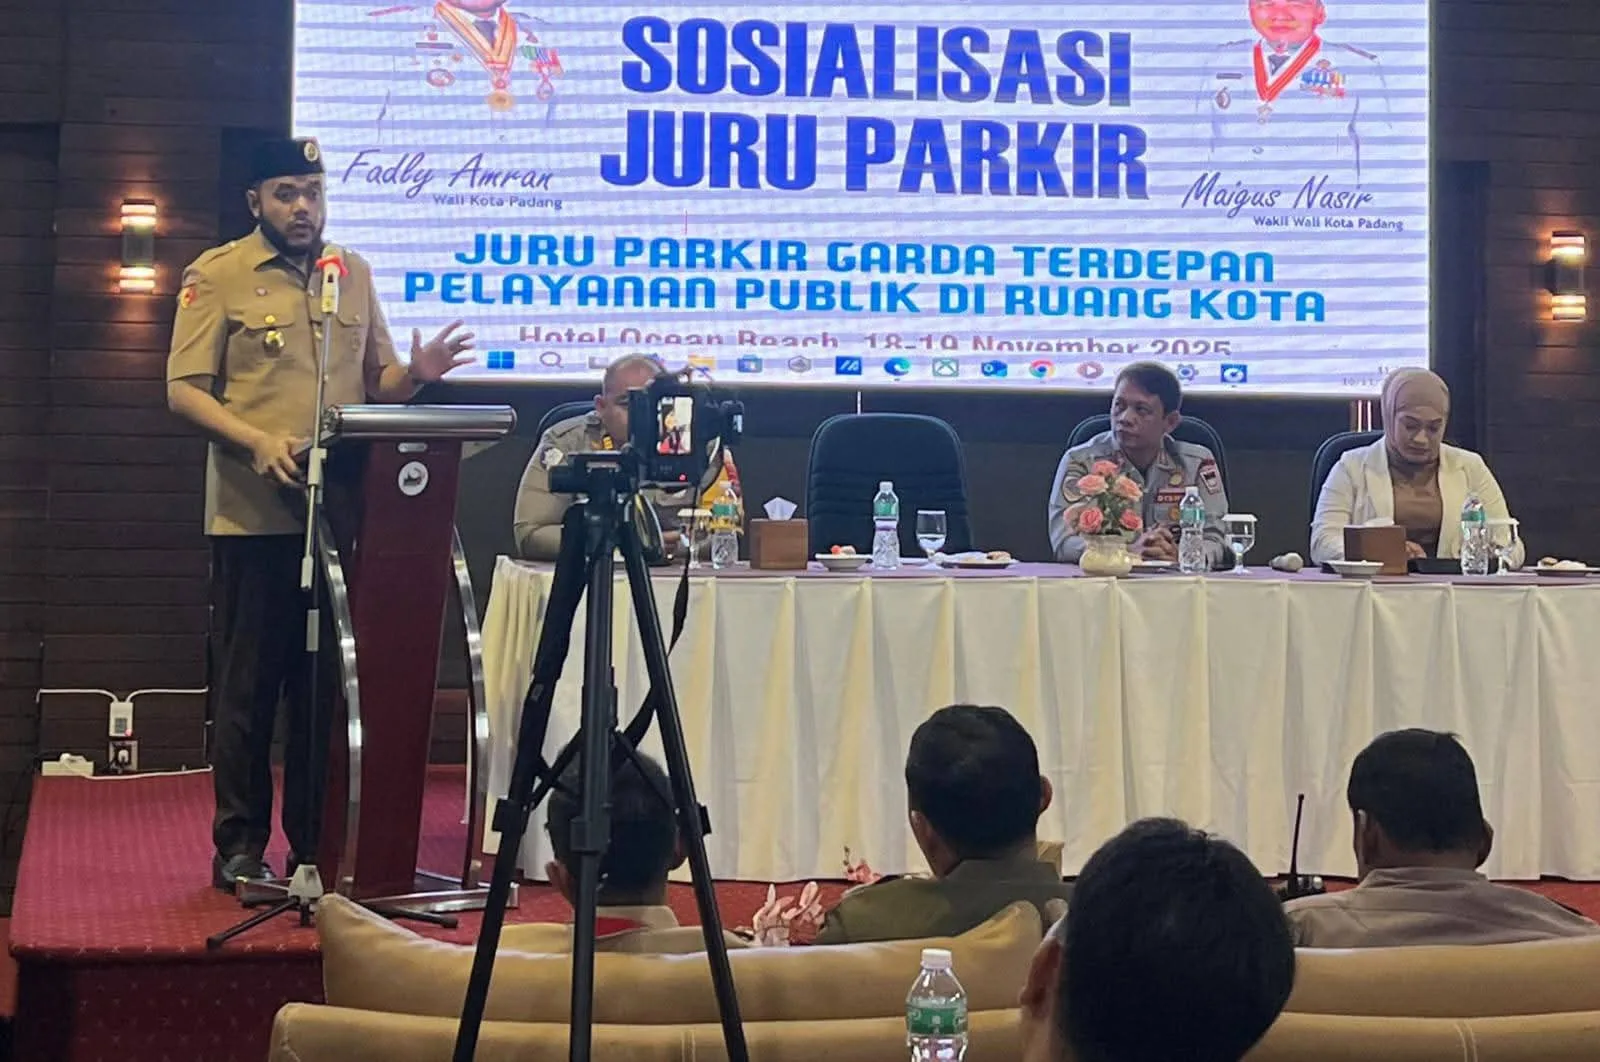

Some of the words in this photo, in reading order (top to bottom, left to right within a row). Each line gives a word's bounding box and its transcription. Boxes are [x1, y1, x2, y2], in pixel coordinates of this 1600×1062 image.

[621, 15, 1131, 107] SOSIALISASI
[342, 149, 433, 199] Fadly
[448, 152, 554, 191] Amran
[600, 109, 817, 189] JURU
[845, 114, 1149, 199] PARKIR
[433, 194, 464, 205] Wali
[470, 195, 504, 207] Kota
[509, 197, 562, 210] Padang
[1181, 171, 1281, 219] Maigus
[1292, 174, 1374, 209] Nasir
[1253, 216, 1288, 226] Wakil
[1293, 217, 1320, 228] Wali
[1325, 217, 1353, 228] Kota
[1358, 218, 1404, 231] Padang
[455, 233, 594, 266] JURU
[614, 237, 806, 272] PARKIR
[827, 242, 995, 276] GARDA
[1013, 246, 1275, 282] TERDEPAN
[405, 273, 715, 308] PELAYANAN
[736, 278, 921, 313] PUBLIK
[939, 283, 985, 315] DI
[1005, 285, 1172, 319] RUANG
[1190, 289, 1326, 323] KOTA
[1150, 339, 1232, 356] 2025
